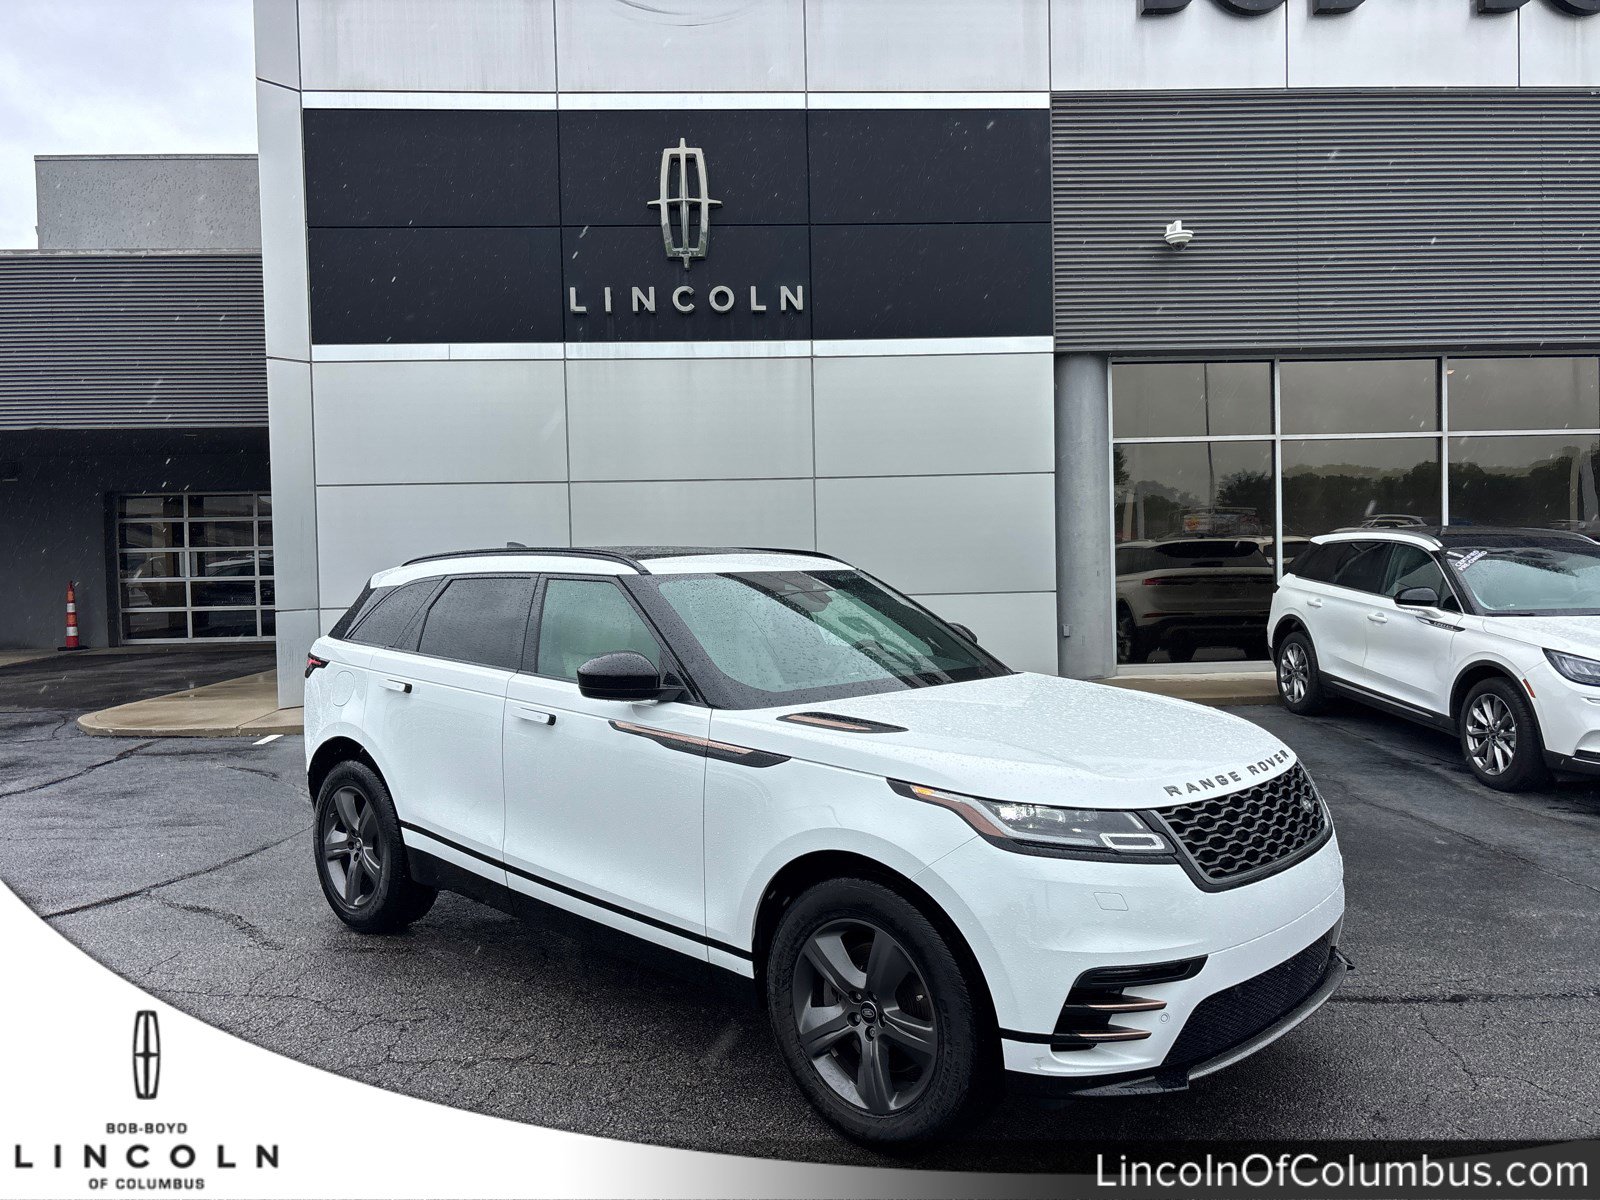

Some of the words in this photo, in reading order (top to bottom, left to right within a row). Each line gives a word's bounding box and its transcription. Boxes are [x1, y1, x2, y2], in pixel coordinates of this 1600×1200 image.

[569, 285, 804, 313] LINCOLN
[1163, 771, 1242, 797] RANGE
[1246, 749, 1289, 776] ROVER
